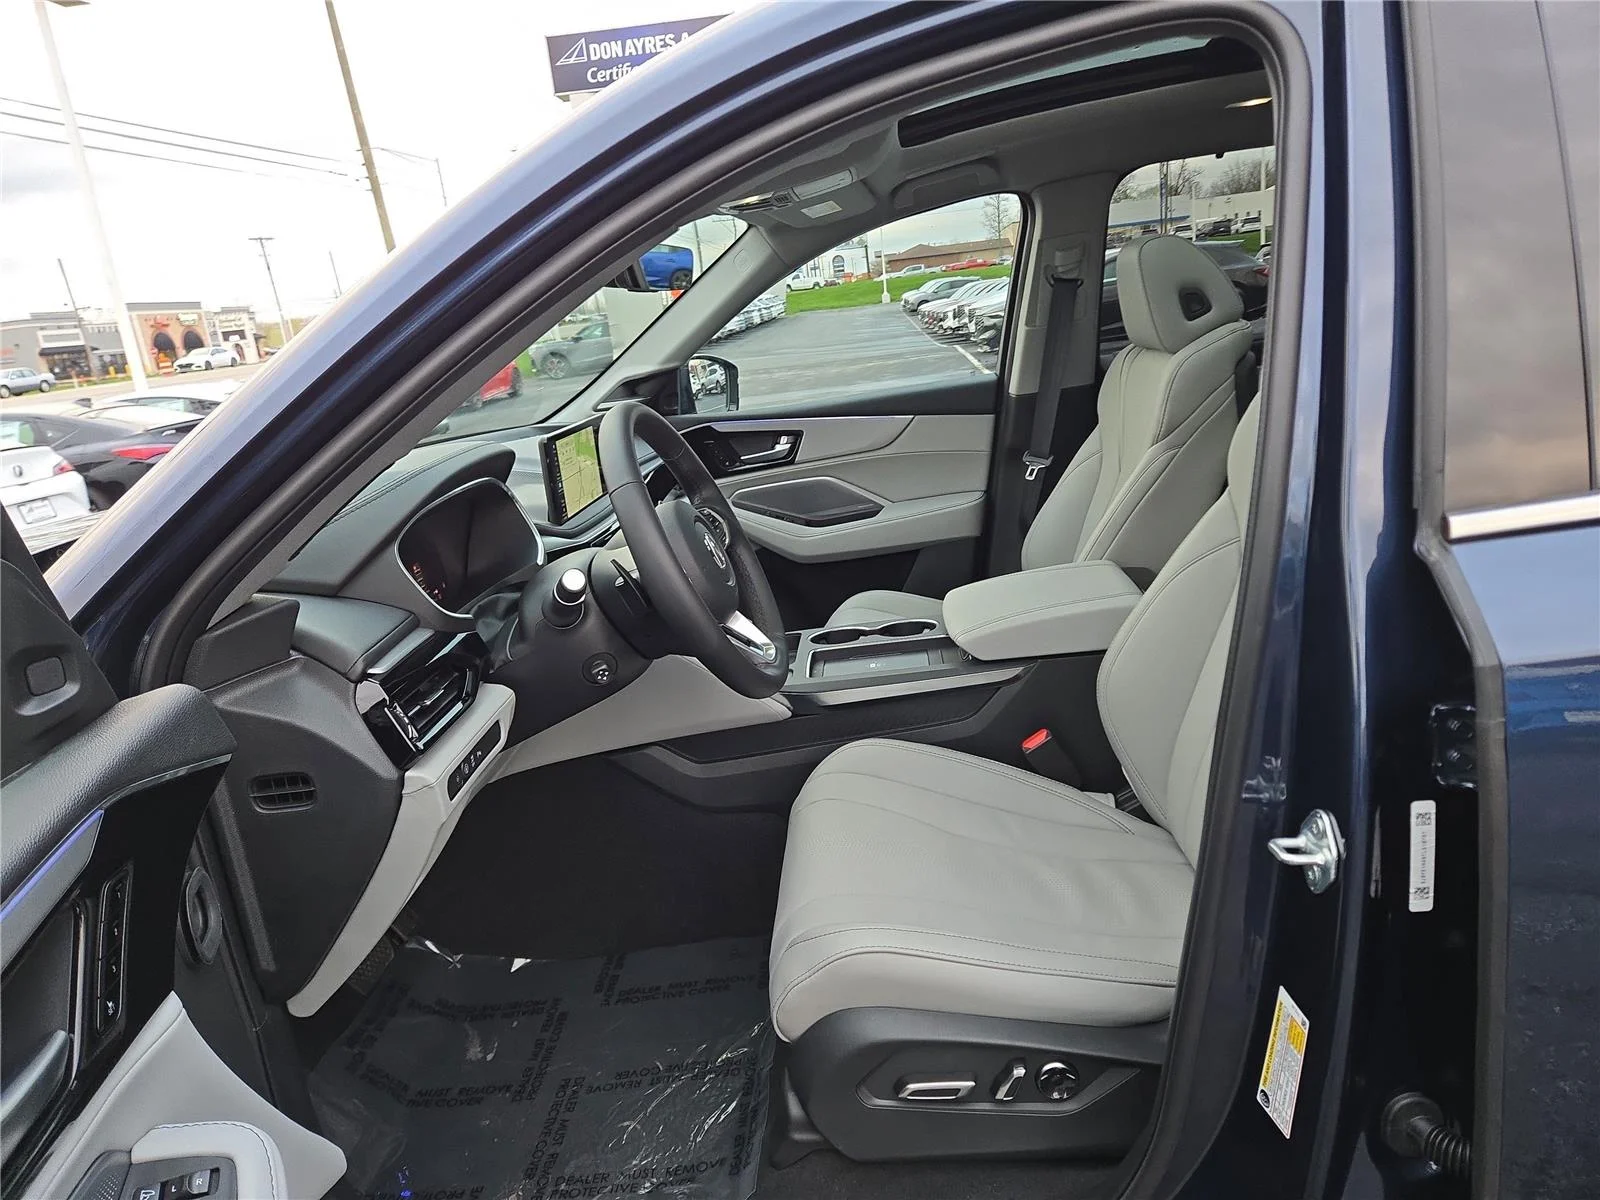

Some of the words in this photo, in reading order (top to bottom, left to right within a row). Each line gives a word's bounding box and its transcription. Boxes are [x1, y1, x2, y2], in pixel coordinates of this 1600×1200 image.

[589, 40, 623, 61] DON
[625, 33, 677, 57] AYRES
[618, 985, 662, 998] DEALER
[613, 1065, 662, 1081] COVER
[584, 1079, 641, 1094] REMOVE
[538, 1078, 572, 1139] PROTECTIVE
[551, 1119, 571, 1146] MUST
[524, 1139, 548, 1181] COVER
[196, 1177, 203, 1186] R
[555, 1172, 610, 1187] DEALER
[171, 1184, 177, 1193] L
